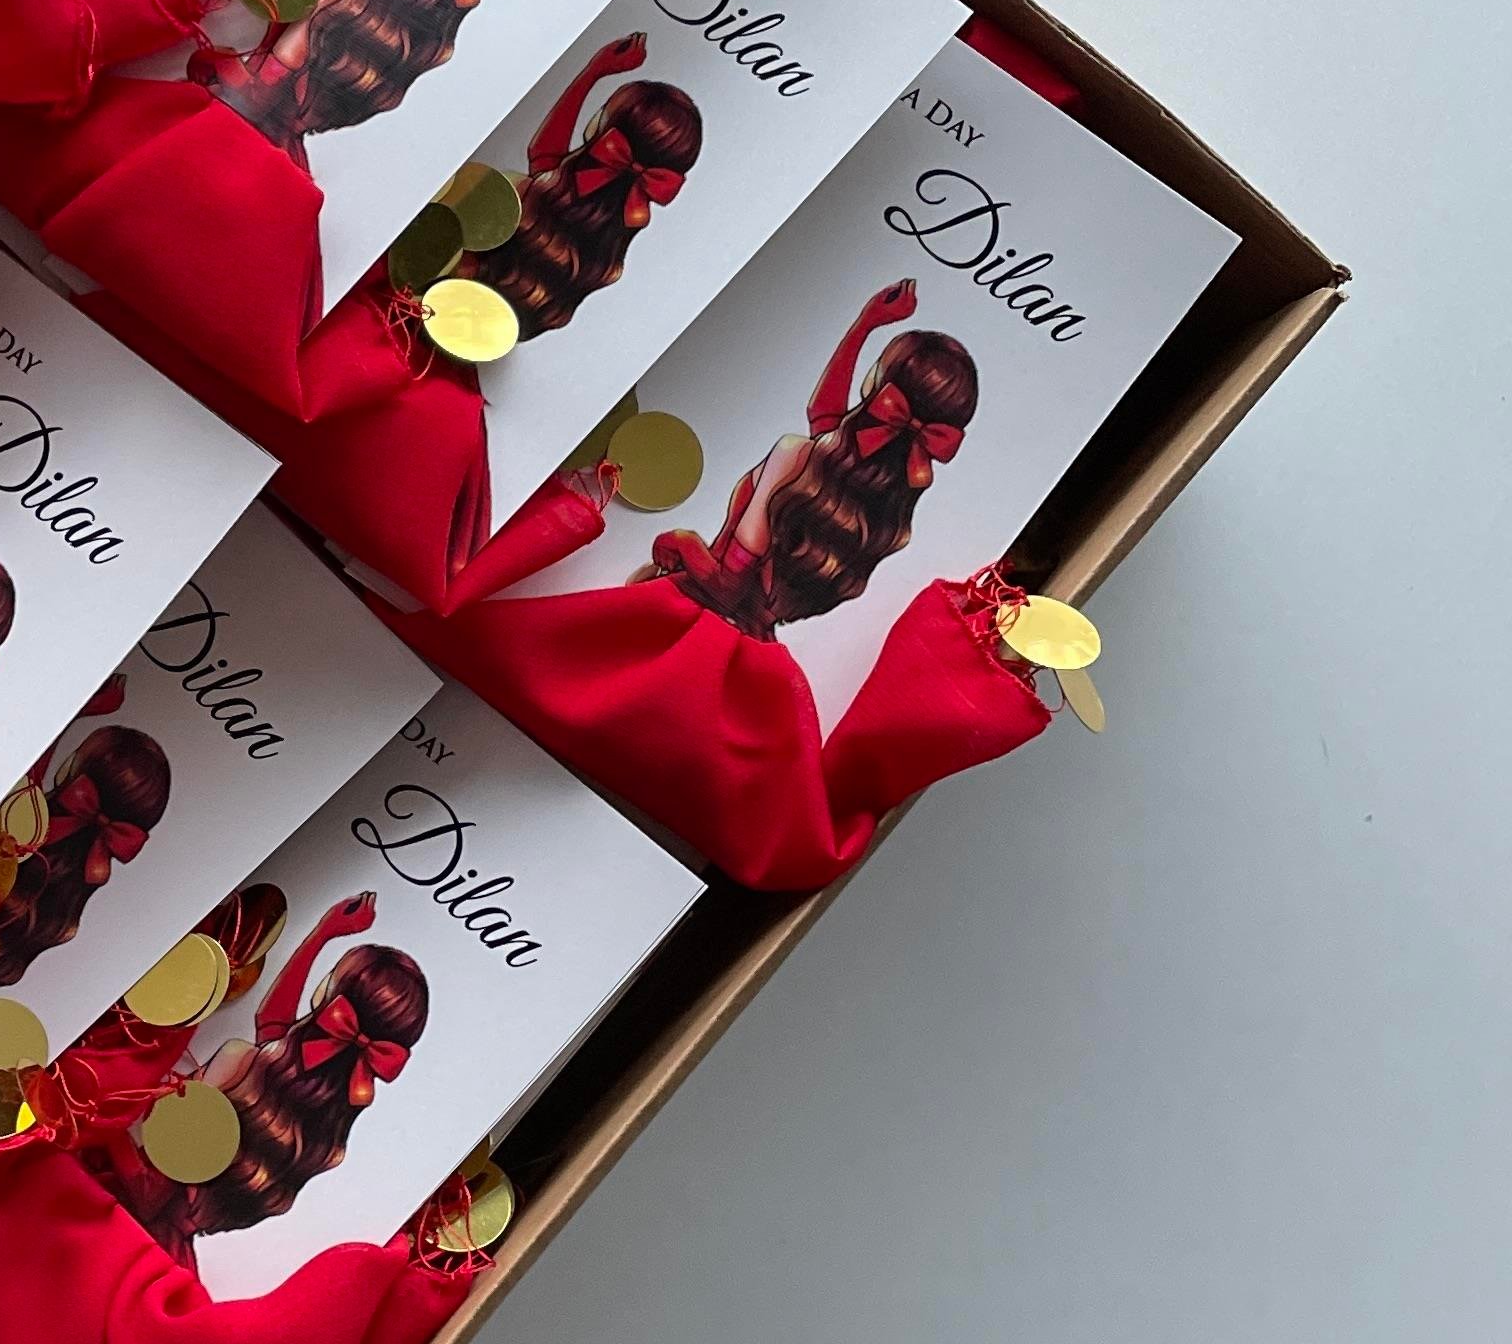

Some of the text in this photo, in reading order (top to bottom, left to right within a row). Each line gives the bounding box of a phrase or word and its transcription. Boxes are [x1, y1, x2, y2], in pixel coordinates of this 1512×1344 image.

[924, 99, 985, 148] DAY
[883, 169, 1086, 342] Dilan
[350, 784, 543, 968] Dilan
